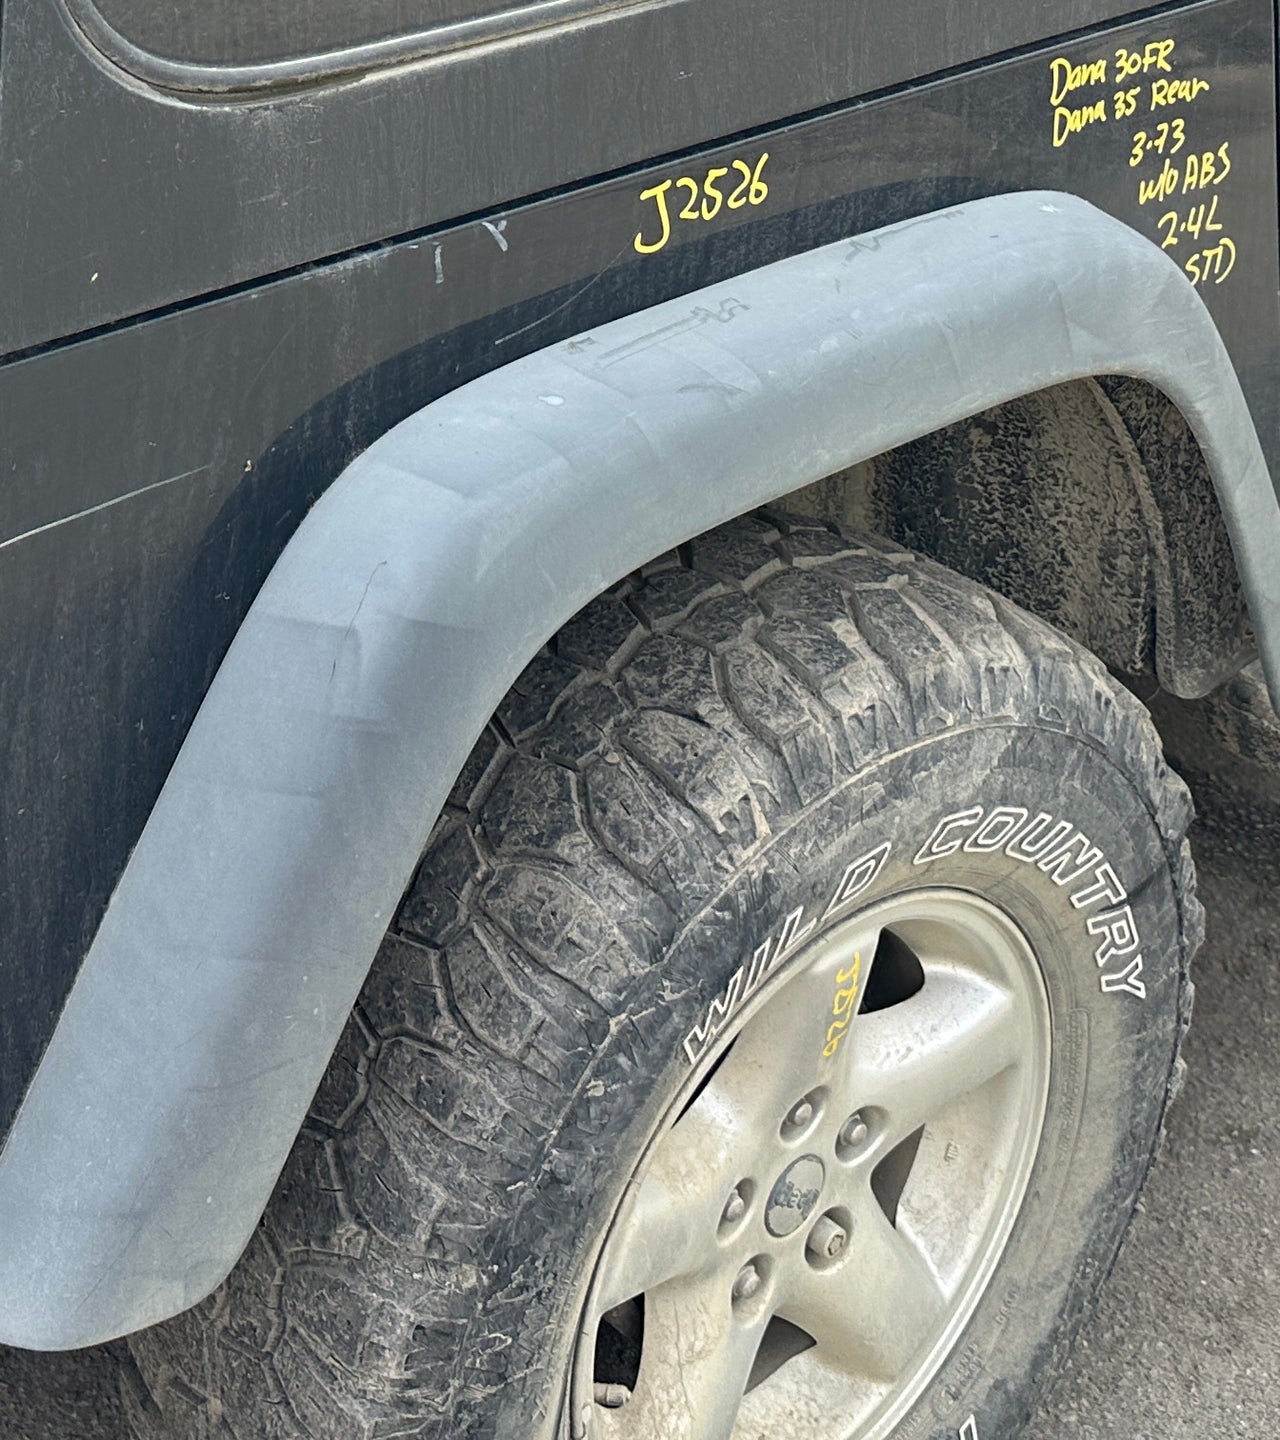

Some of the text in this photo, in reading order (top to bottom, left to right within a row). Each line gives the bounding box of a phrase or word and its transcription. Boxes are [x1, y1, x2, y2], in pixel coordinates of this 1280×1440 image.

[1050, 58, 1107, 106] Dana
[1052, 77, 1210, 148] Dana 35 Rear
[1182, 141, 1231, 195] ABS
[635, 152, 769, 254] J2526
[1157, 194, 1222, 249] 2.4L
[1184, 237, 1236, 286] STD
[683, 805, 1147, 1062] WILD COUNTRY
